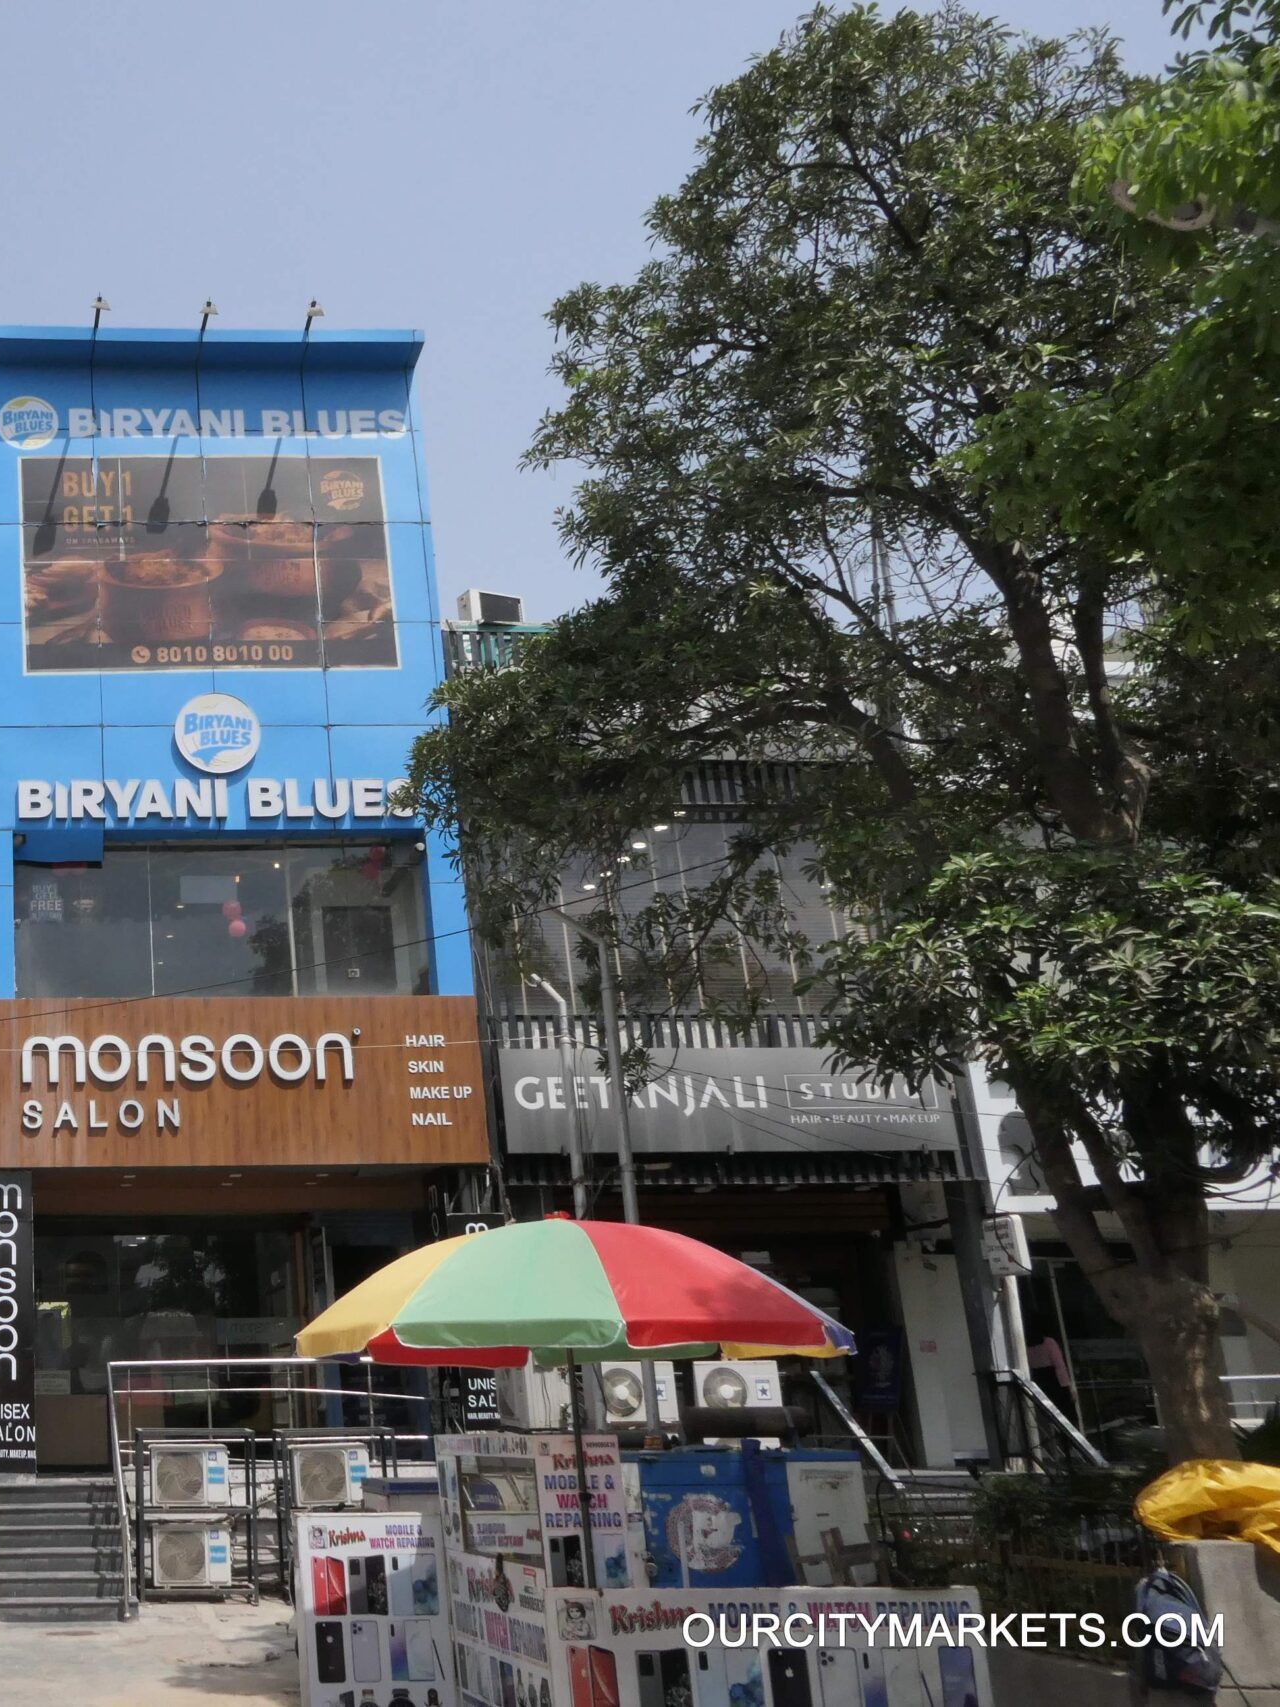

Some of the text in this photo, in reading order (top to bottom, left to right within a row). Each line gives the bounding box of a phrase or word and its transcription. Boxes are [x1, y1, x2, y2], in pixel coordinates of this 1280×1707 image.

[3, 410, 53, 426] BIRYANI
[69, 408, 408, 439] BIRYANI BLUES
[15, 421, 52, 433] BLUES
[63, 471, 132, 497] BUY 1
[320, 480, 363, 494] BIRYANI
[331, 488, 363, 499] BLUES
[64, 506, 133, 531] GET 1
[157, 645, 293, 663] 8010 8010 00
[184, 712, 253, 736] BIRYANI
[200, 728, 252, 747] BLUES
[18, 777, 418, 820] BIRYANI BLUES
[31, 899, 62, 911] FREE
[406, 1034, 445, 1048] HAIR
[22, 1032, 354, 1085] monsoon
[408, 1060, 445, 1074] SKIN
[410, 1086, 472, 1100] MAKE UP
[23, 1099, 181, 1130] SALON
[411, 1113, 453, 1126] NAIL
[791, 1114, 941, 1125] HAIR BEAUTY MAKEUP
[468, 1378, 497, 1390] UNIS
[468, 1394, 497, 1408] SAL
[552, 1451, 615, 1471] Krihna
[544, 1474, 615, 1490] MOBLE &
[545, 1512, 622, 1528] REPARING
[328, 1527, 366, 1548] Krishna
[385, 1524, 415, 1536] MOBILE
[370, 1537, 435, 1549] WATCH REPAIRING
